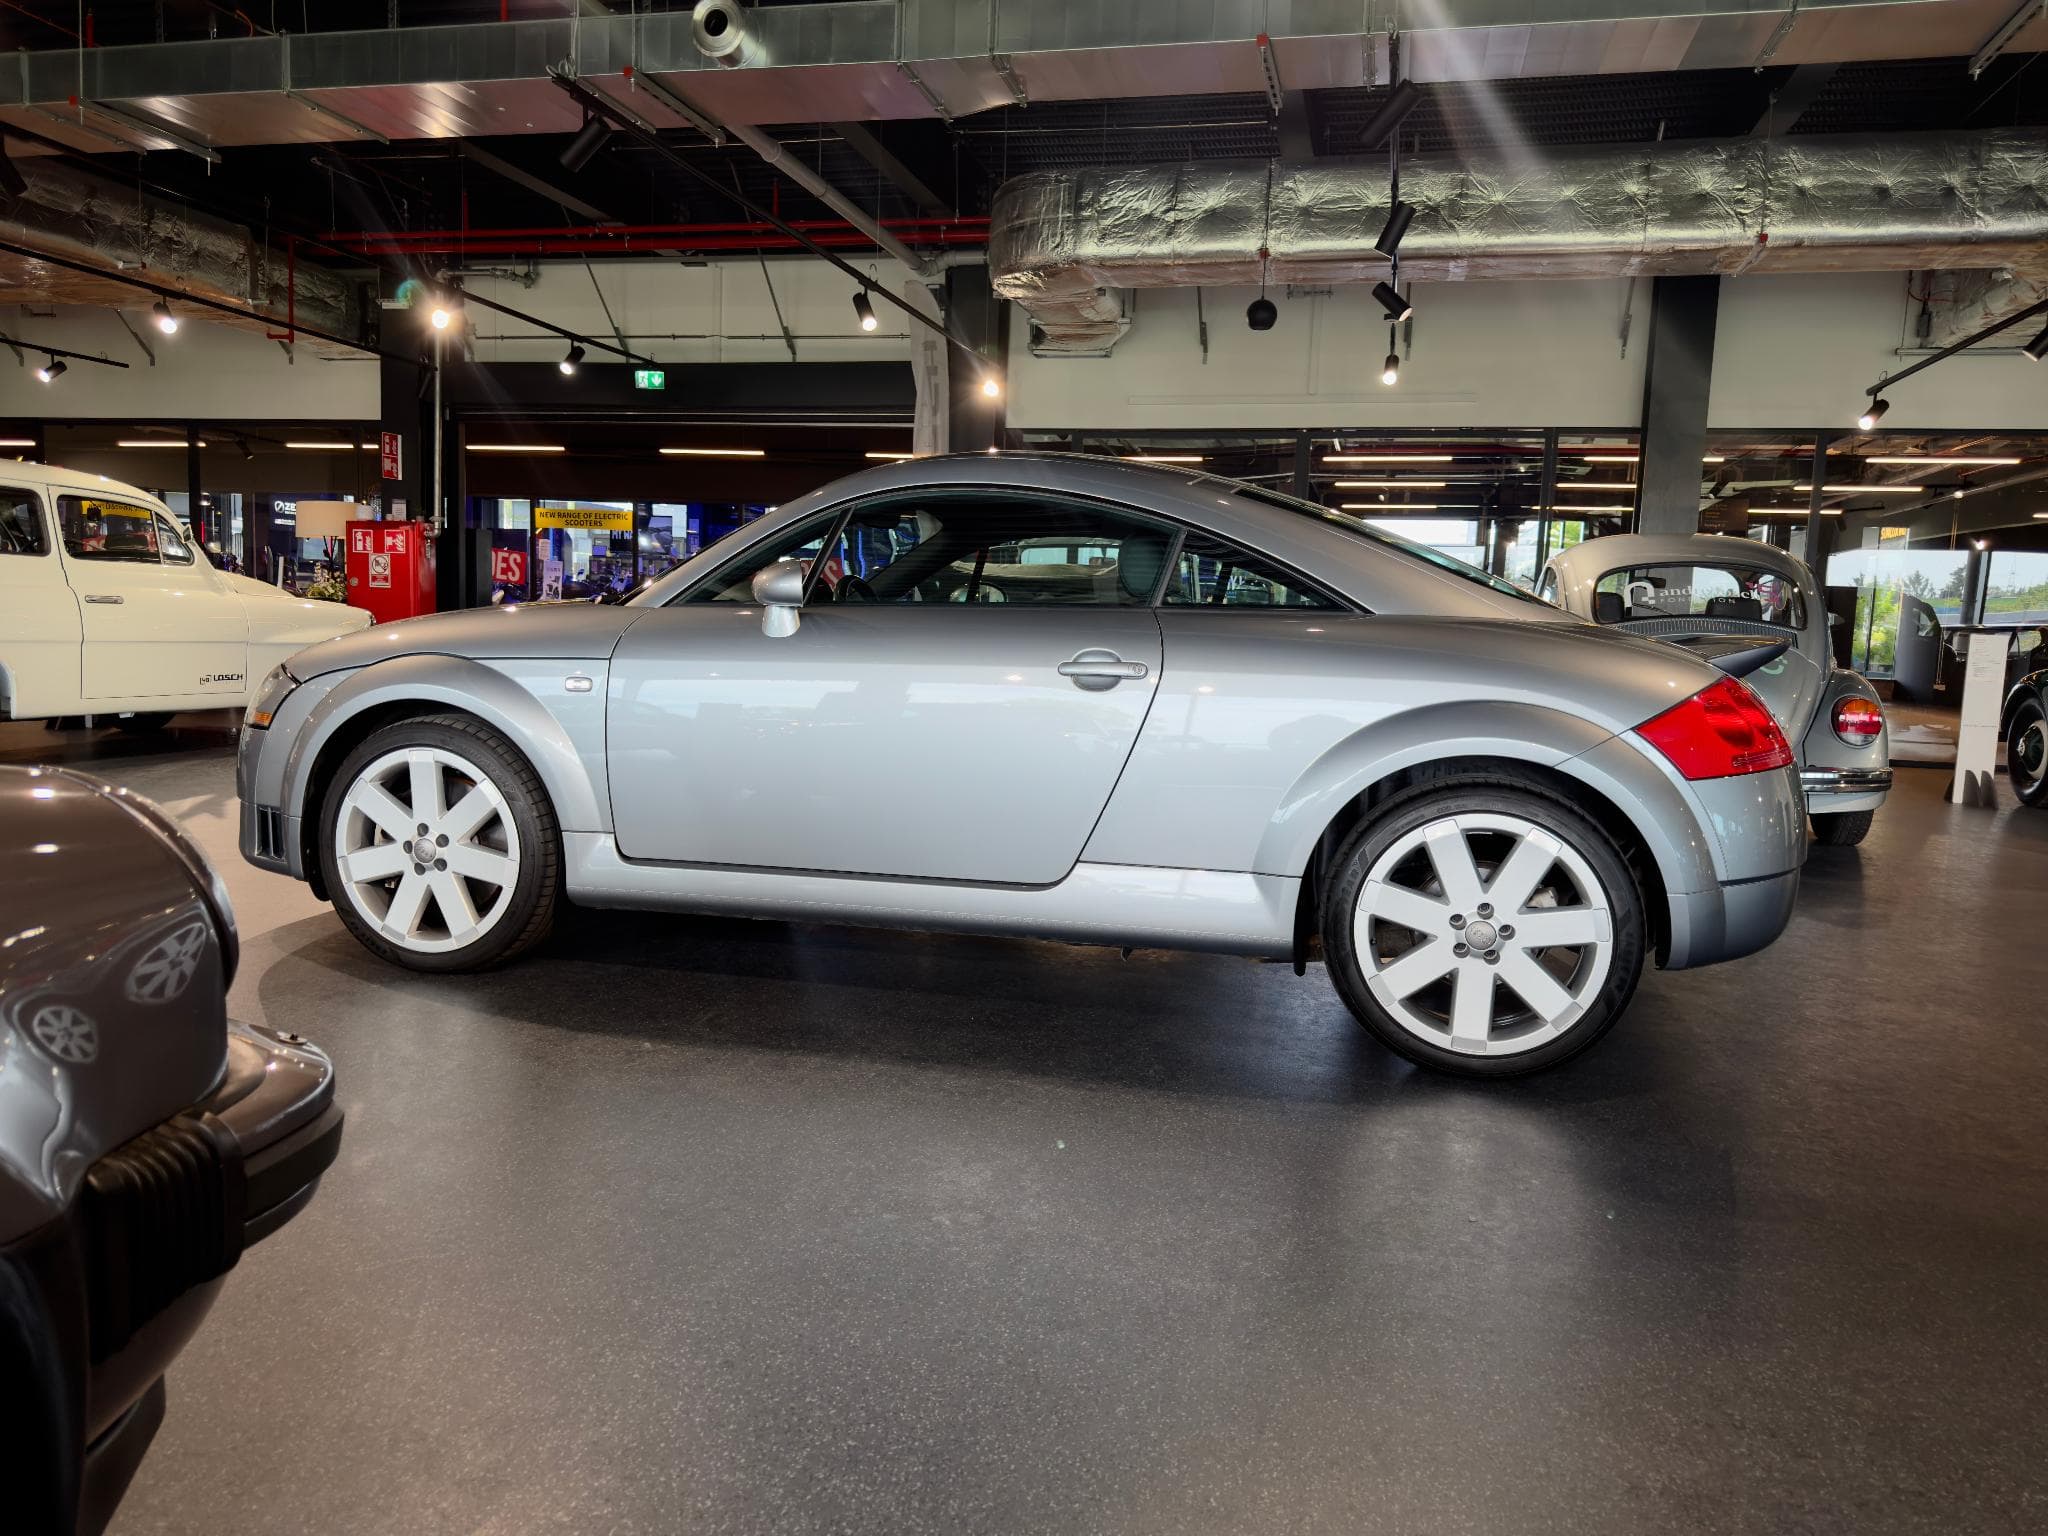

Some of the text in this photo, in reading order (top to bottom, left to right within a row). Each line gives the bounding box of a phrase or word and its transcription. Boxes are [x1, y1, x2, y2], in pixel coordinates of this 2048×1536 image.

[539, 511, 556, 519] NEW
[557, 511, 581, 519] RANGE
[594, 512, 629, 520] ELECTRIC
[564, 519, 604, 527] SCOOTERS
[213, 674, 244, 682] LOSCH
